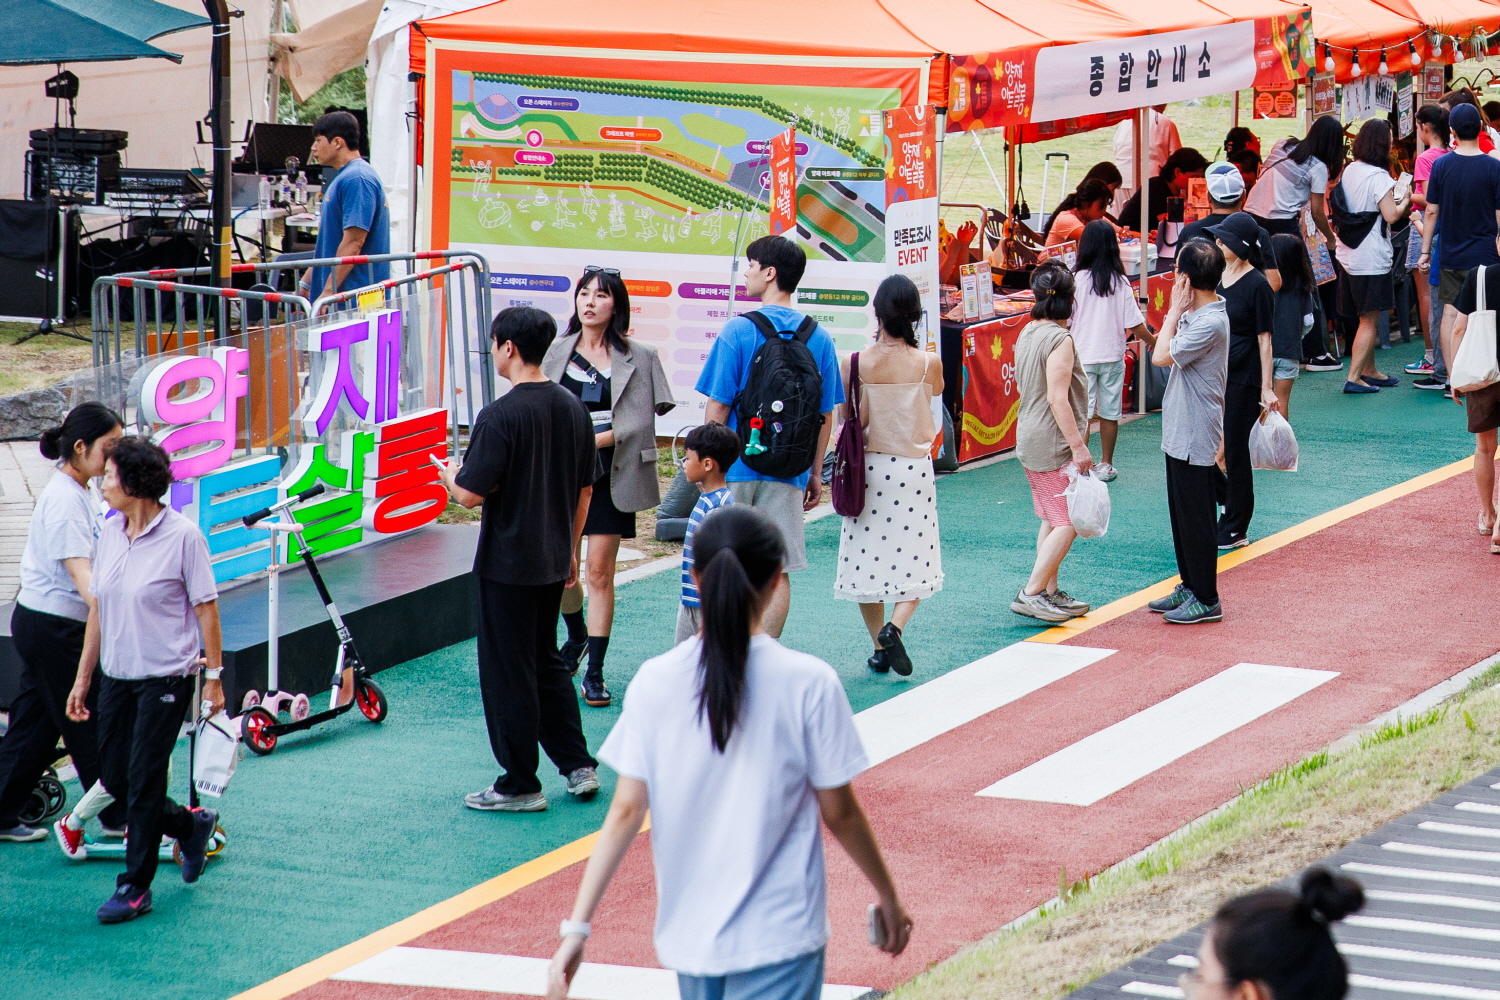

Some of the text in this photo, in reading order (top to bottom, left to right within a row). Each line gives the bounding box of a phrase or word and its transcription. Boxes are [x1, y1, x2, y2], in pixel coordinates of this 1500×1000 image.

[1089, 41, 1211, 97] 종합안내소
[894, 224, 931, 248] 만족도조사
[898, 246, 929, 266] EVENT
[503, 277, 527, 286] 스테이지
[141, 309, 401, 480] 양재
[105, 407, 449, 583] 트살롱
